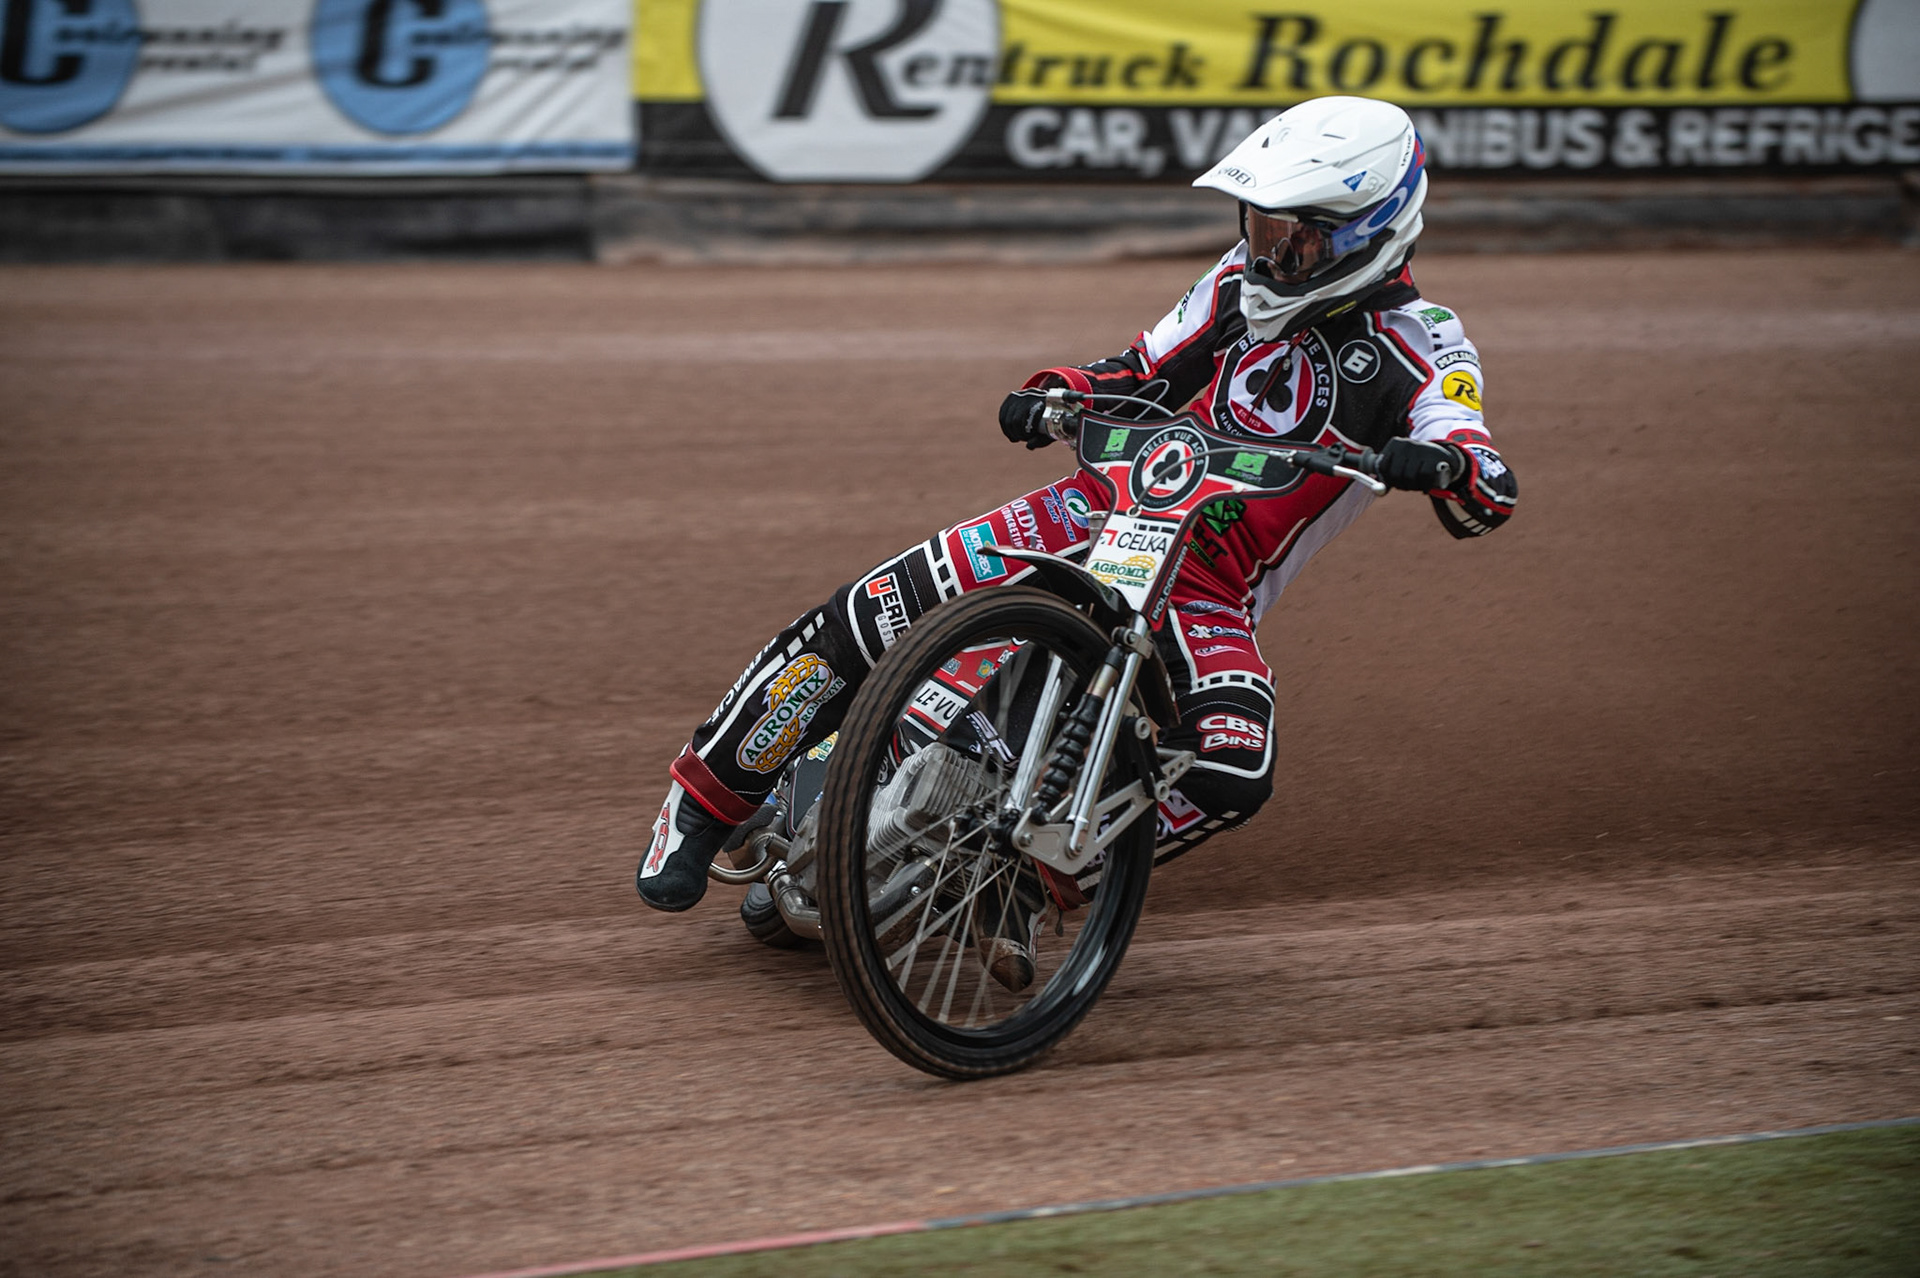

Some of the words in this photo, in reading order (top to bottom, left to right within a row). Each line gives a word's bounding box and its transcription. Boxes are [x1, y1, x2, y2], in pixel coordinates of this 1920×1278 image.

[1234, 10, 1795, 93] Rochdale
[1005, 107, 1166, 178] CAR,
[1168, 107, 1278, 169] VA
[1611, 107, 1661, 169] &
[1314, 362, 1330, 409] ACES
[1141, 433, 1170, 458] BELLE
[1174, 431, 1194, 443] VUE
[1191, 442, 1205, 466] ACS
[1000, 507, 1025, 548] CONCRETIN
[1117, 531, 1168, 556] CELKA
[1091, 561, 1150, 579] AGROMIX
[876, 613, 895, 645] GOST
[744, 670, 827, 763] AGROMIX
[1200, 715, 1265, 740] CBS
